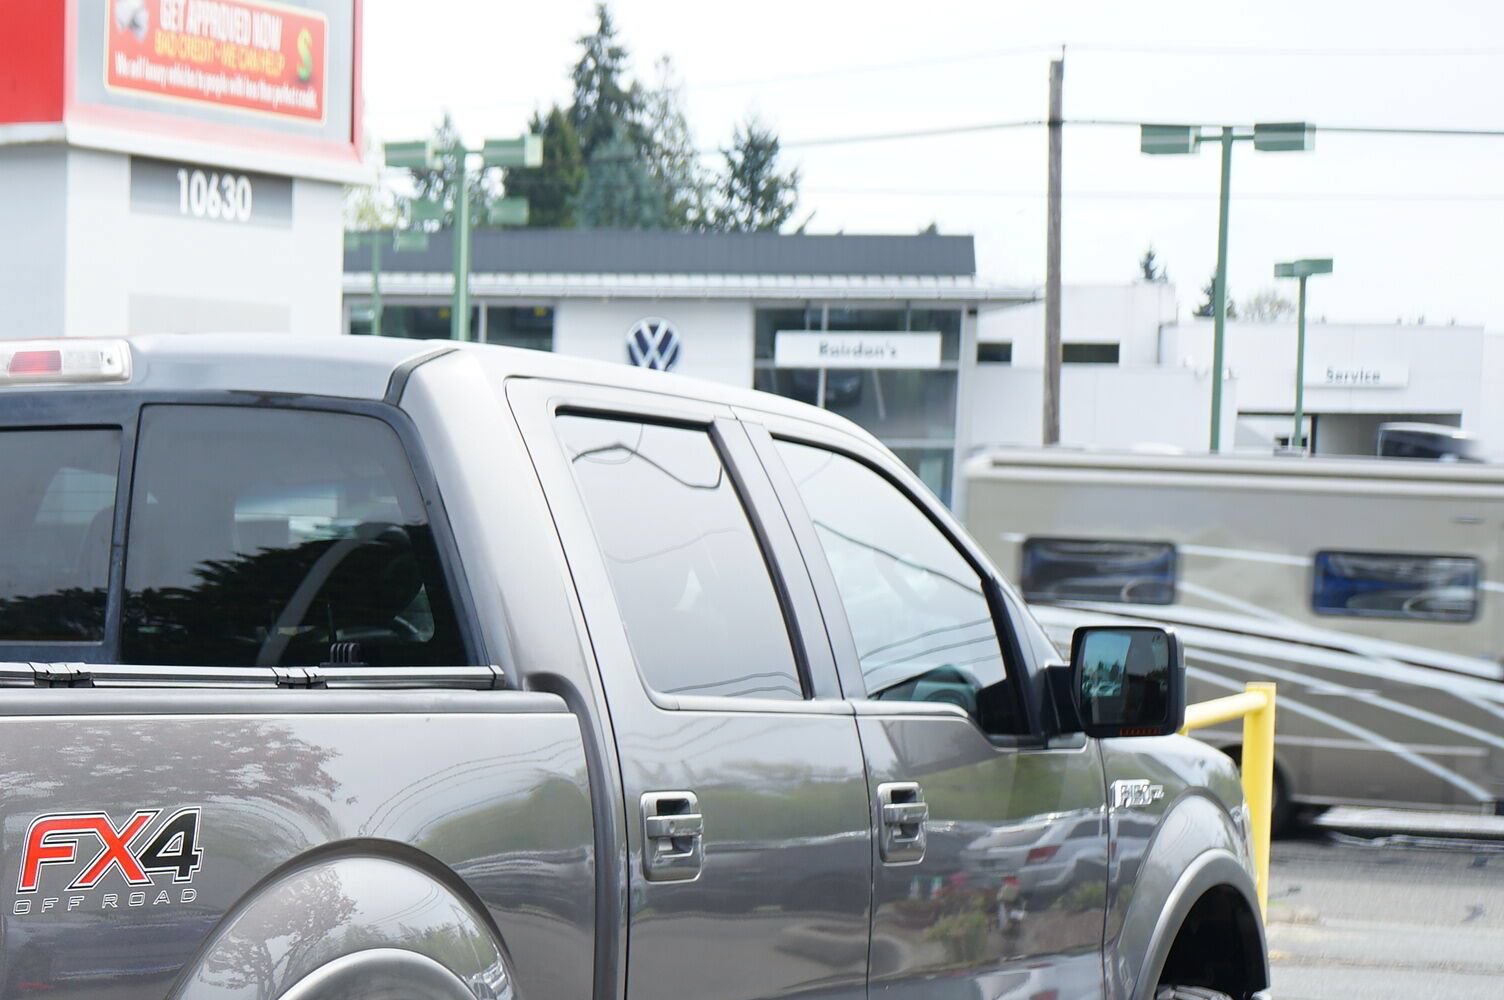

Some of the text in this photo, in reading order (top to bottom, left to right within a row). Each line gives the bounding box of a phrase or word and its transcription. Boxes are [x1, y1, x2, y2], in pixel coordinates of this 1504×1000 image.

[186, 0, 251, 47] APPROVED
[253, 10, 283, 52] NOW
[177, 168, 253, 223] 10630
[1325, 365, 1382, 385] Service
[15, 805, 205, 895] FX4
[12, 888, 198, 915] OFF ROAD
